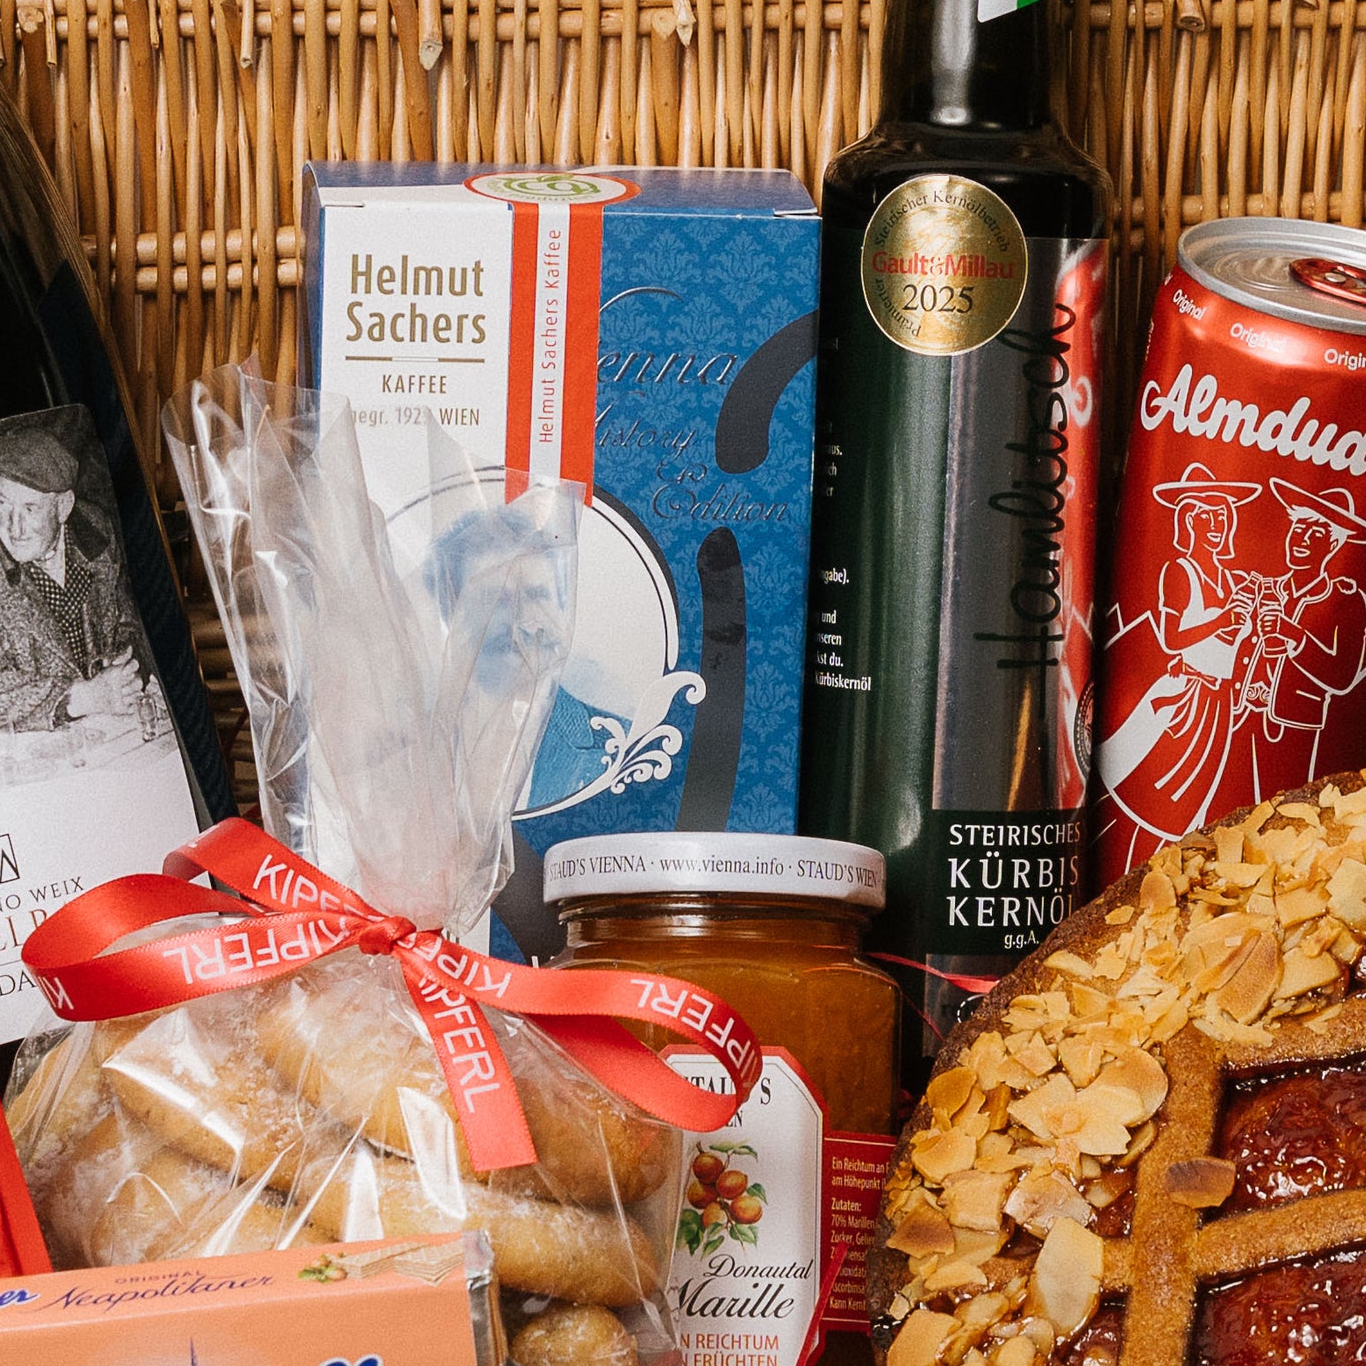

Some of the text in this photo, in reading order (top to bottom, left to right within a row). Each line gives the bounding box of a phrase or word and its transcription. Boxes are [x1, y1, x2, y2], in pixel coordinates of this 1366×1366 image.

[875, 190, 1008, 253] Steirischer Kernölbetrieb
[350, 254, 484, 297] Helmut
[872, 250, 1014, 279] Gault&Millau
[902, 284, 975, 314] 2025
[1172, 289, 1207, 321] Original
[346, 301, 486, 344] Sachers
[538, 228, 562, 443] Helmut Sachers Kaffee
[382, 374, 447, 394] KAFFEE
[439, 408, 480, 426] WIEN
[821, 568, 850, 585] gabe).
[949, 821, 1081, 846] STEIRISCHES
[548, 857, 586, 881] STAUD'S
[589, 855, 646, 874] VIENNA
[659, 855, 784, 877] www.vienna.info
[797, 863, 854, 883] STAUD'S
[948, 851, 1079, 890] KÜRBIS
[29, 876, 85, 903] WEIX
[163, 916, 349, 984] KIPFERL
[1004, 930, 1040, 950] g.g.A.
[844, 1158, 876, 1174] Reichtum
[703, 1254, 814, 1280] Donautal
[19, 1275, 274, 1314] Neapolitaner
[667, 1278, 794, 1319] Marille
[695, 1333, 779, 1350] REICHTUM
